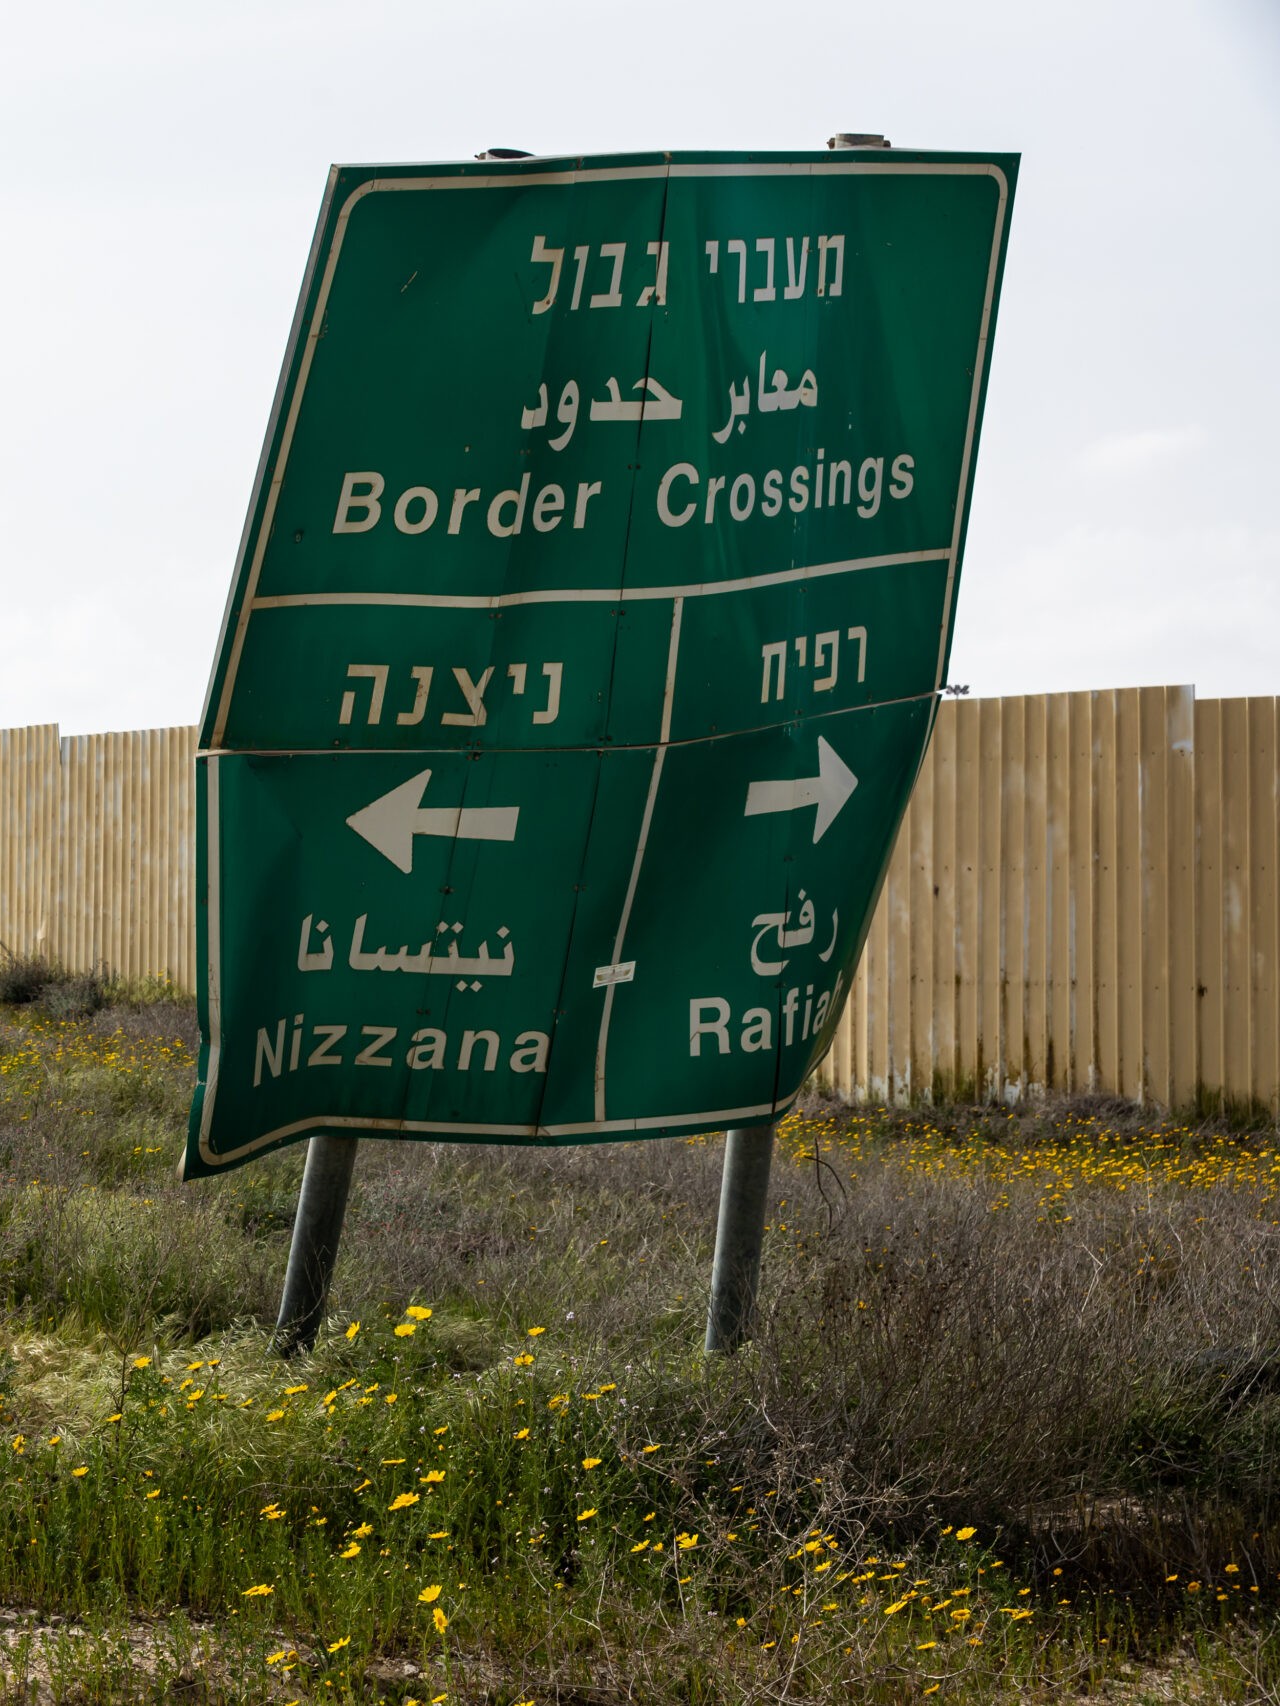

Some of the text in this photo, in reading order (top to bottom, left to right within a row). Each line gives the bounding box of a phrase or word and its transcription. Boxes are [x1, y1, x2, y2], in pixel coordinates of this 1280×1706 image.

[529, 234, 846, 316] מעברי גבול
[520, 350, 820, 452] معابر حدود
[331, 447, 916, 538] Border Crossings
[338, 661, 564, 728] ניצנה
[760, 625, 868, 704] רפיח
[296, 912, 516, 993] نيتسانا
[749, 887, 840, 977] رفح
[252, 1011, 551, 1088] Nizzana
